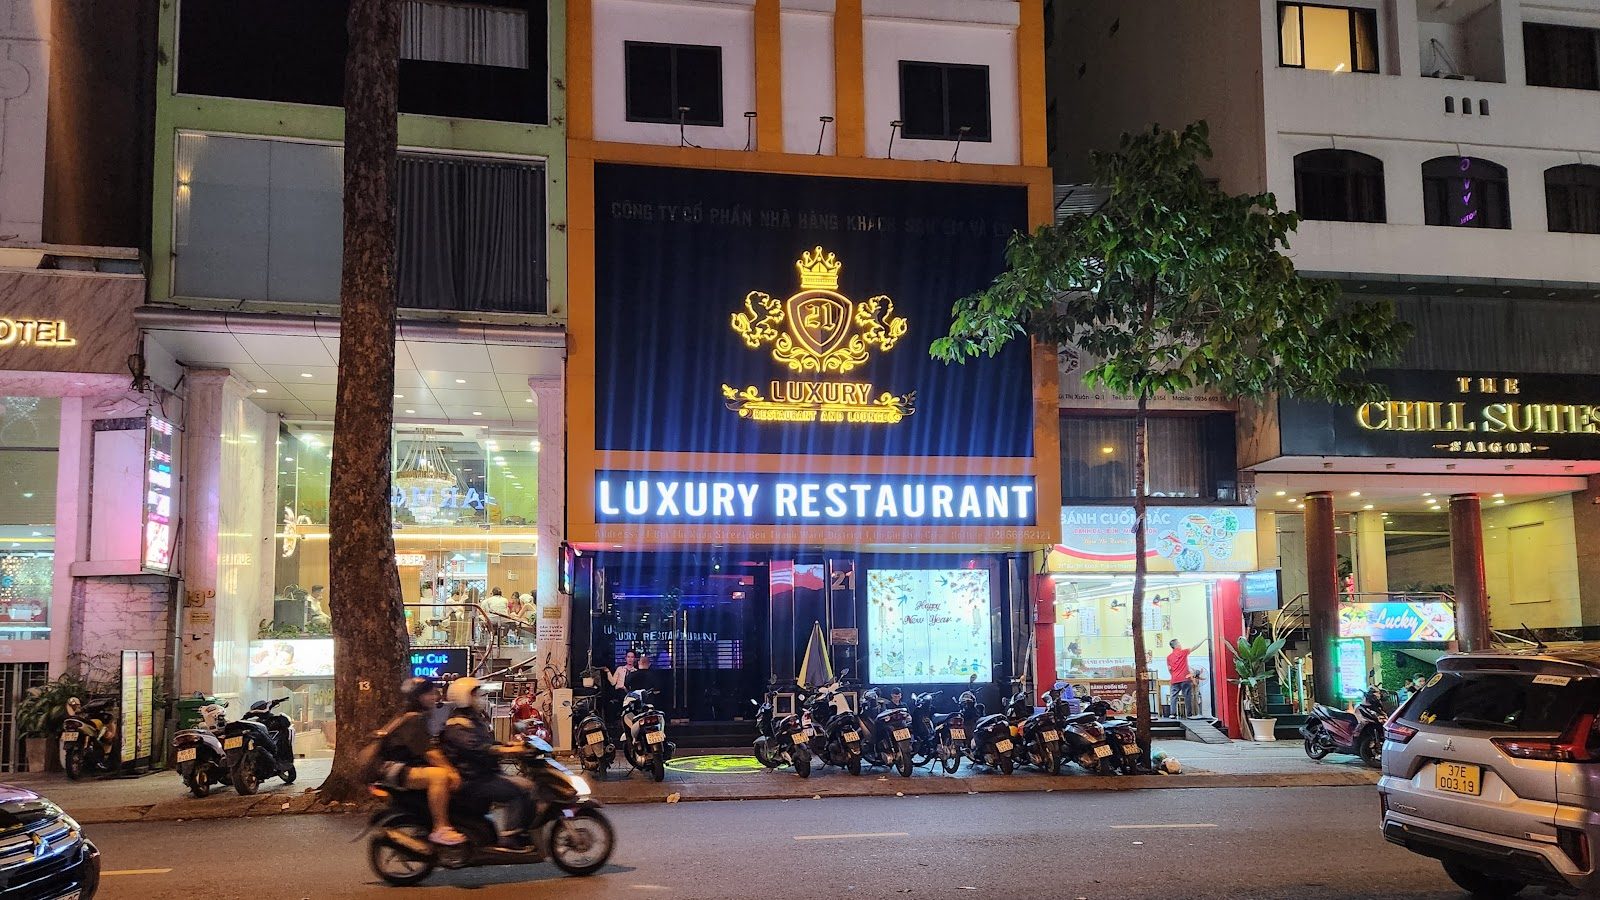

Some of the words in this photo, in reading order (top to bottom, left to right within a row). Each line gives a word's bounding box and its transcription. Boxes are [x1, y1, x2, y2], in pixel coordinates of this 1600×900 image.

[804, 302, 836, 331] 21
[771, 380, 873, 405] LUXURY
[1456, 376, 1521, 395] THE
[752, 409, 817, 422] RESTAURANT
[820, 410, 844, 422] AND
[1355, 400, 1476, 432] CHILL
[1449, 440, 1533, 454] SAIGON
[599, 479, 760, 518] LUXURY
[774, 482, 1034, 519] RESTAURANT
[831, 570, 855, 591] 21
[914, 600, 942, 612] Happy
[902, 614, 925, 625] New
[928, 613, 953, 627] Year
[1373, 607, 1419, 634] Lucky
[426, 653, 448, 664] Cut
[358, 681, 371, 691] 13
[1448, 764, 1466, 778] 37E
[1440, 777, 1474, 793] 003.19
